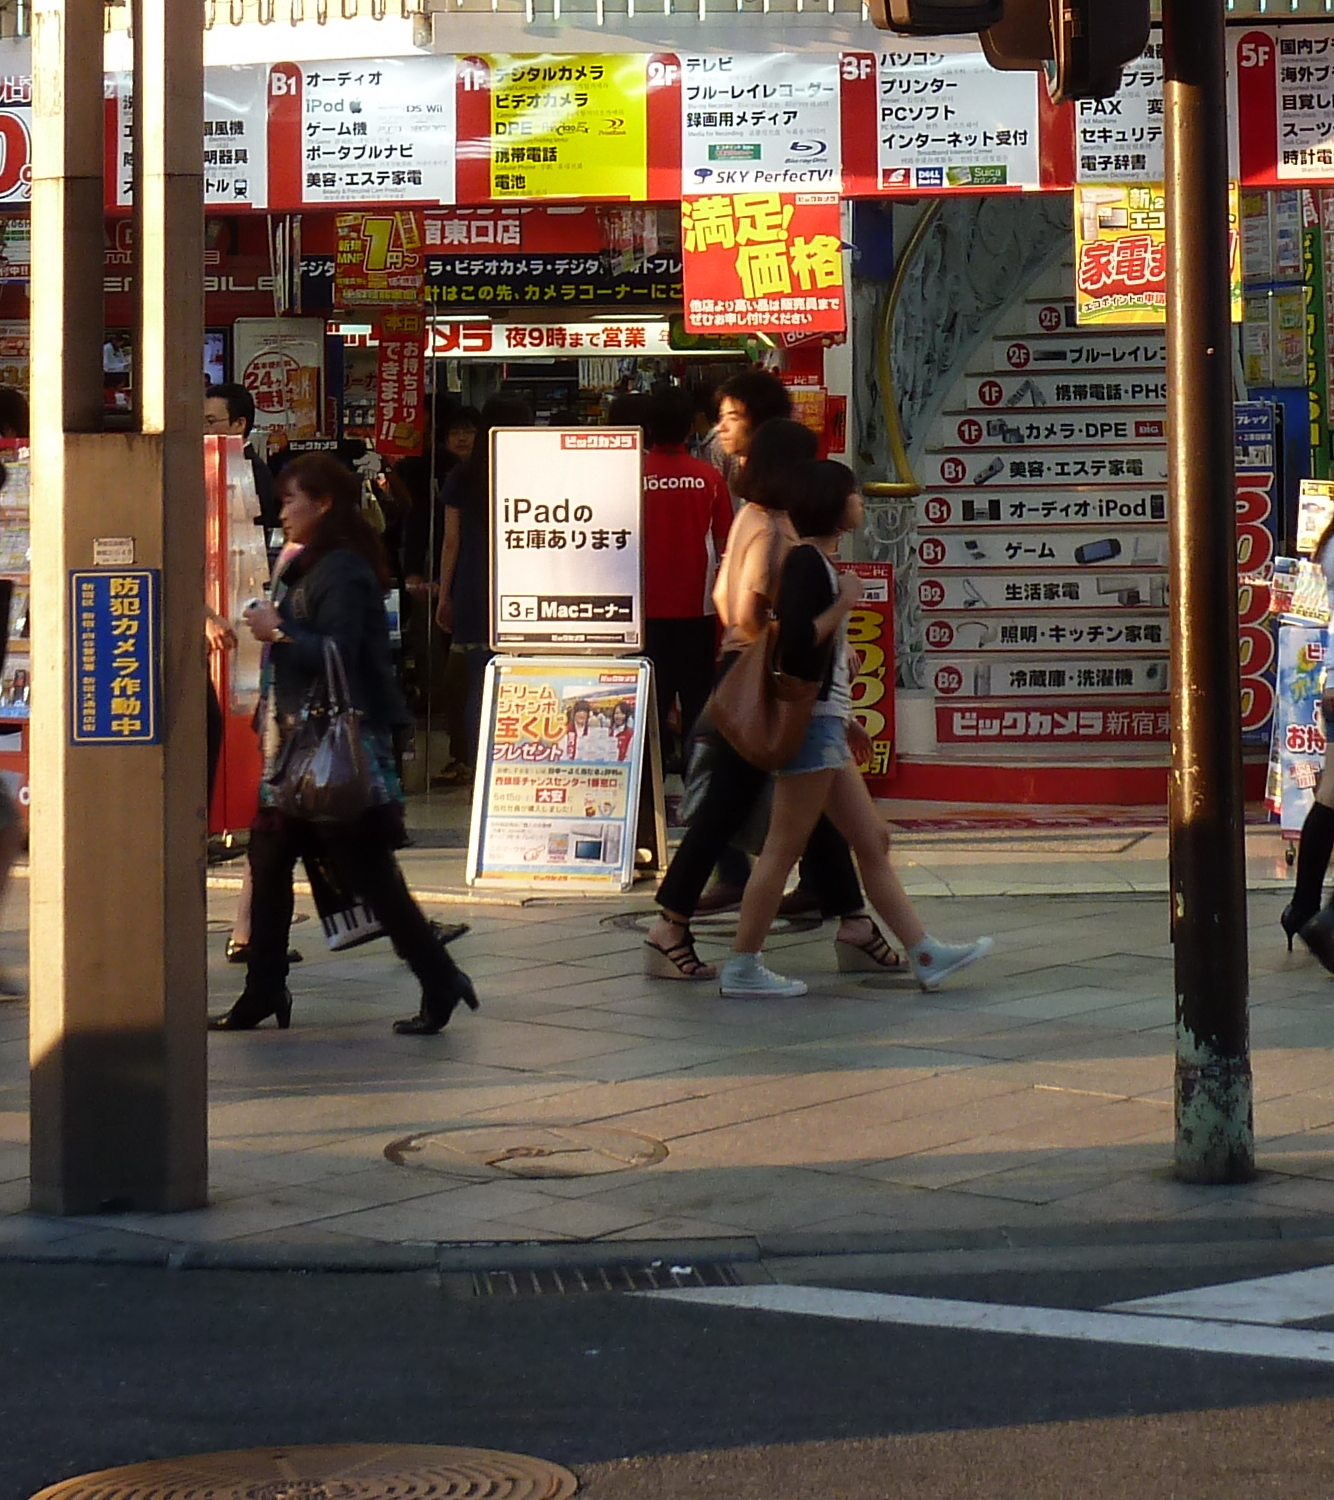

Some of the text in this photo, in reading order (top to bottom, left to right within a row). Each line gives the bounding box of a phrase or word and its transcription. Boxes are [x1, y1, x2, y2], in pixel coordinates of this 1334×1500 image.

[881, 51, 945, 67] パソコン
[1240, 43, 1270, 67] 5F
[496, 65, 604, 82] デジタルカメラ
[686, 57, 733, 73] テレビ
[842, 57, 872, 80] 3F
[306, 71, 383, 88] オーディオ
[460, 67, 486, 91] 1F
[648, 61, 678, 87] 2F
[271, 72, 298, 96] B1
[686, 82, 835, 101] ブルーレイレコーダー
[881, 78, 958, 94] プリンター
[306, 98, 444, 114] iPod Wii
[495, 93, 588, 109] ビデオカメラ
[1080, 100, 1122, 115] FAX
[686, 110, 799, 128] 録画用メディア
[881, 105, 956, 122] PCソフト
[306, 121, 368, 137] ゲーム機
[495, 121, 533, 136] DPE
[1080, 127, 1163, 143] セキュリテ
[882, 129, 1029, 150] インターネット受付
[306, 143, 414, 161] ポータブルナビ
[495, 146, 557, 164] 携帯電話
[974, 167, 1003, 177] Suica
[1080, 155, 1146, 172] 電子辞書
[306, 169, 423, 187] 美容・エステ家電
[495, 173, 526, 190] 電池
[716, 169, 834, 184] SKY PerfecTV!
[682, 192, 794, 253] 満足!
[337, 253, 364, 263] MNP
[735, 235, 843, 299] 価格
[689, 297, 841, 313] 他店より高い品は販売員まで
[384, 316, 417, 332] 本日
[689, 312, 814, 326] ぜひお申し付けください
[1041, 312, 1060, 326] 2F
[505, 326, 647, 349] 夜9時まで営業
[1009, 349, 1028, 364] 2F
[402, 341, 418, 424] お持ち帰り
[982, 386, 1001, 401] 1F
[961, 425, 980, 439] 1F
[1026, 422, 1127, 440] カメラ・DPE
[289, 440, 338, 450] ビックカメラ
[565, 435, 633, 448] ビックカメラ
[943, 464, 964, 479] B1
[1010, 458, 1143, 478] 美容・エステ家電
[504, 498, 593, 524] iPadの
[928, 503, 948, 518] B1
[1009, 498, 1147, 519] オーディオ・iPod
[505, 528, 632, 550] 在庫あります
[922, 544, 943, 560] B1
[1005, 542, 1056, 560] ゲーム
[920, 585, 942, 601] B2
[1005, 583, 1080, 601] 生活家電
[508, 601, 535, 618] 3F
[541, 601, 630, 619] Macコーナー
[929, 626, 950, 642] B2
[1000, 625, 1162, 644] 照明・キッチン家電
[109, 577, 142, 736] 防犯カメラ作動中
[937, 672, 959, 688] B2
[1009, 668, 1134, 688] 冷蔵庫・洗濯機
[500, 685, 554, 699] ドリーム
[498, 700, 557, 715] ジャンボ
[496, 716, 567, 740] 宝くじ
[953, 711, 1103, 736] ビックカメラ
[493, 742, 563, 762] プレゼント
[538, 789, 564, 802] 大安
